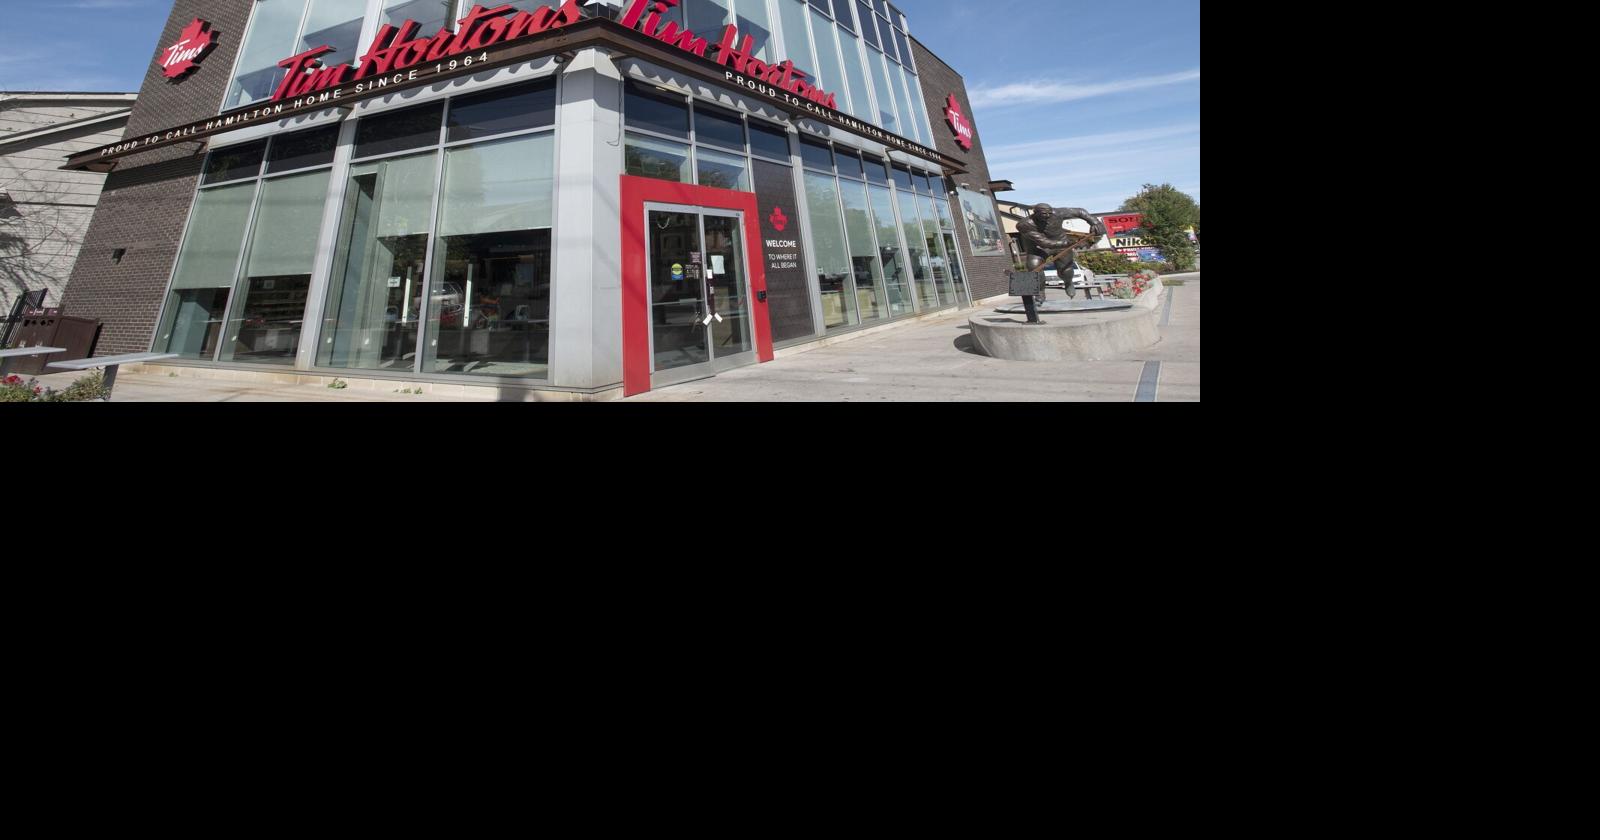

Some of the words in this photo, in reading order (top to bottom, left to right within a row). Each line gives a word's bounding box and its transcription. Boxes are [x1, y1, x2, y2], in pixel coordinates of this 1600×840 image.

[164, 38, 206, 67] Tims
[272, 44, 351, 101] Tim
[352, 0, 582, 82] Hortons
[619, 0, 708, 57] Tim
[713, 23, 838, 110] Hortons
[101, 140, 138, 156] PROUD
[144, 135, 159, 145] TO
[165, 125, 197, 139] CALL
[205, 104, 283, 131] HAMILTON
[294, 88, 342, 110] HOME
[355, 69, 418, 94] SINCE
[435, 51, 489, 74] 1964
[725, 71, 776, 97] PROUD
[783, 93, 799, 106] TO
[806, 103, 833, 120] CALL
[838, 115, 883, 138] HAMILTON
[886, 134, 906, 147] HOME
[908, 143, 928, 155] SINCE
[929, 151, 942, 161] 1964
[949, 109, 973, 140] Tims
[766, 240, 796, 248] WELCOME
[1108, 216, 1141, 224] SON
